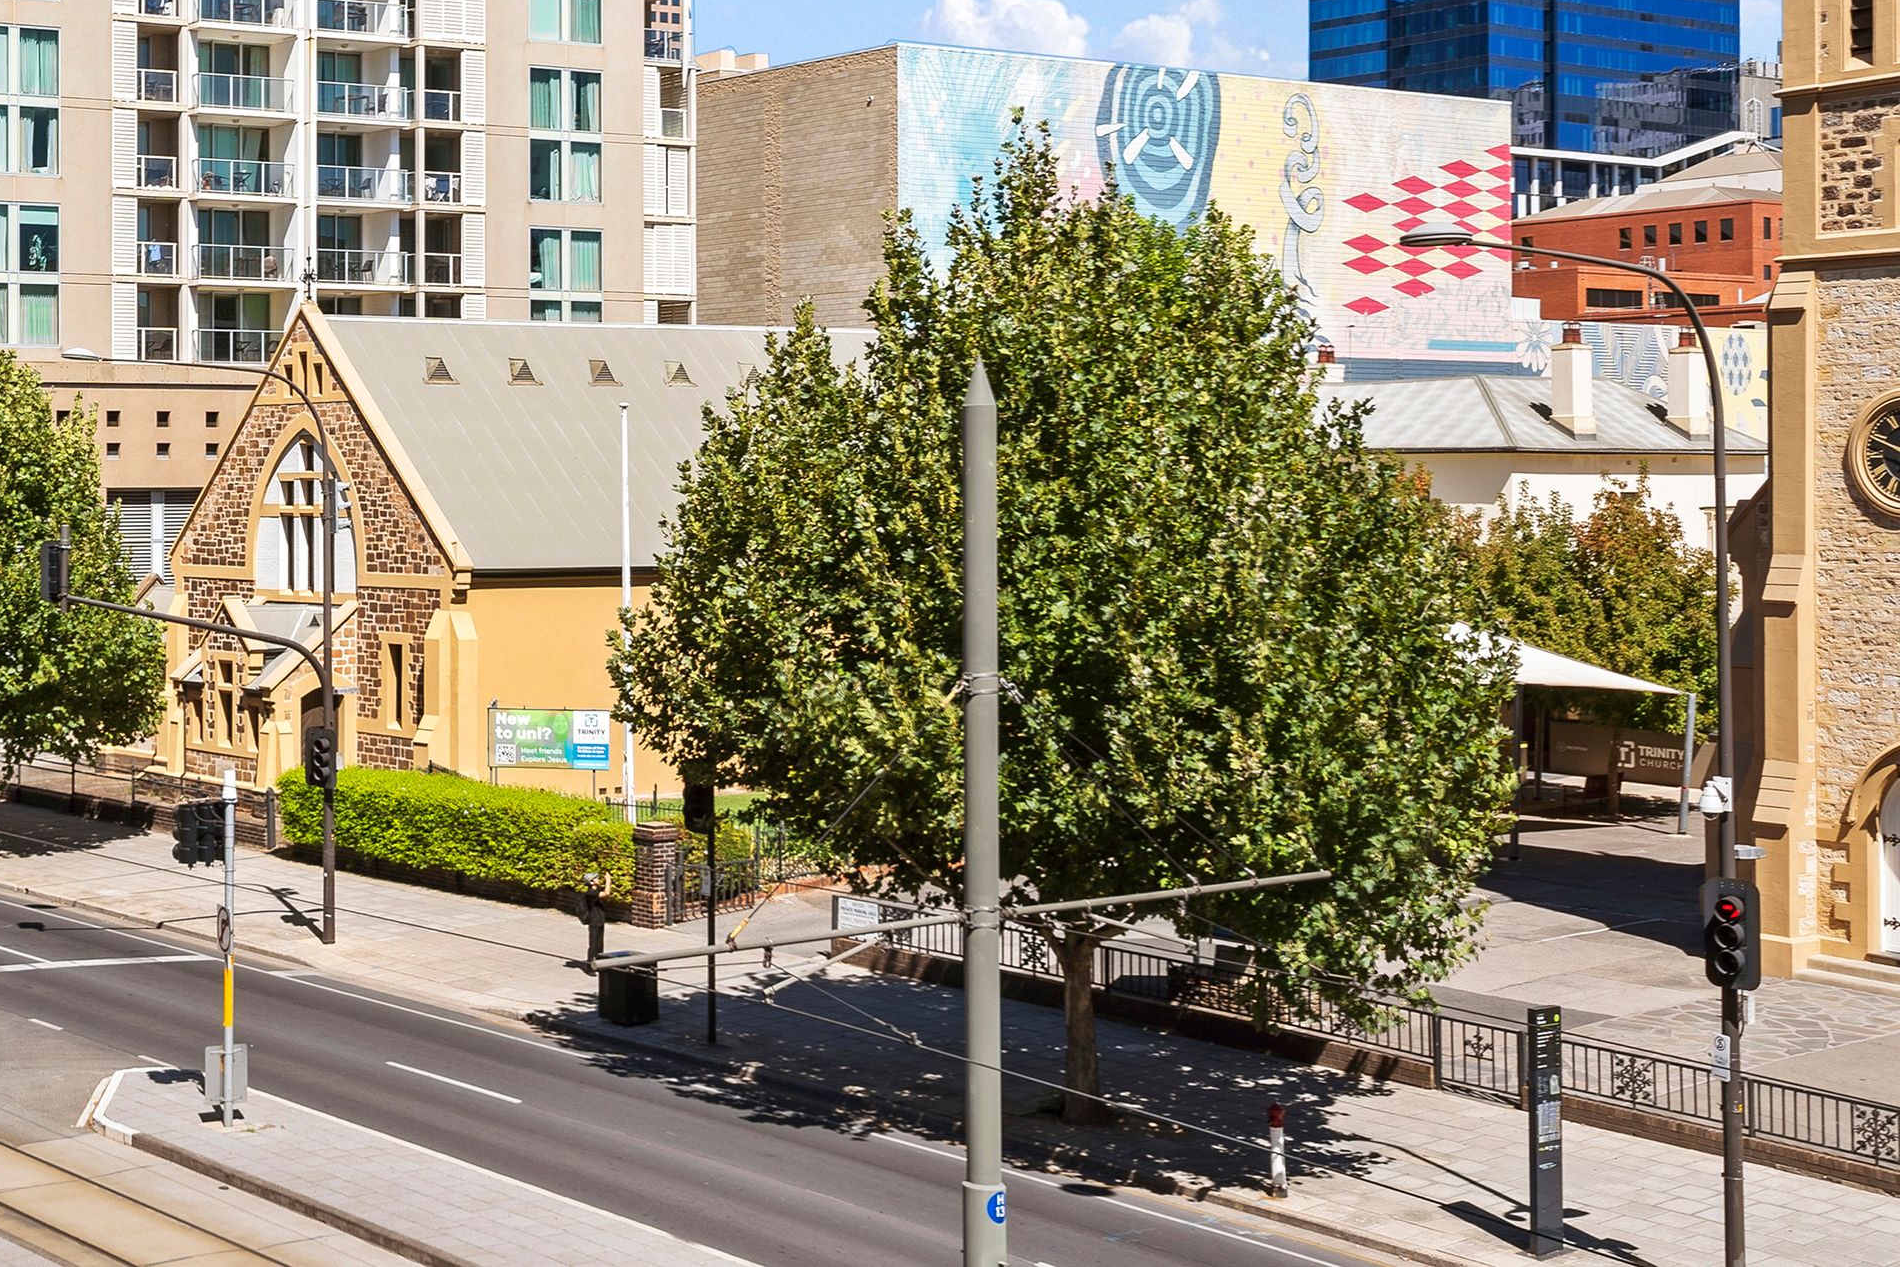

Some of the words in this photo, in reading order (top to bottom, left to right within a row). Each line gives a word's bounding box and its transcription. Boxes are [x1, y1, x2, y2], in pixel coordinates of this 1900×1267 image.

[495, 712, 531, 725] New
[495, 726, 513, 739] to
[516, 727, 552, 740] uni?
[1638, 745, 1685, 760] TRINITY
[1639, 758, 1684, 771] CHURCH
[996, 1194, 1005, 1205] H
[995, 1205, 1005, 1218] 13
